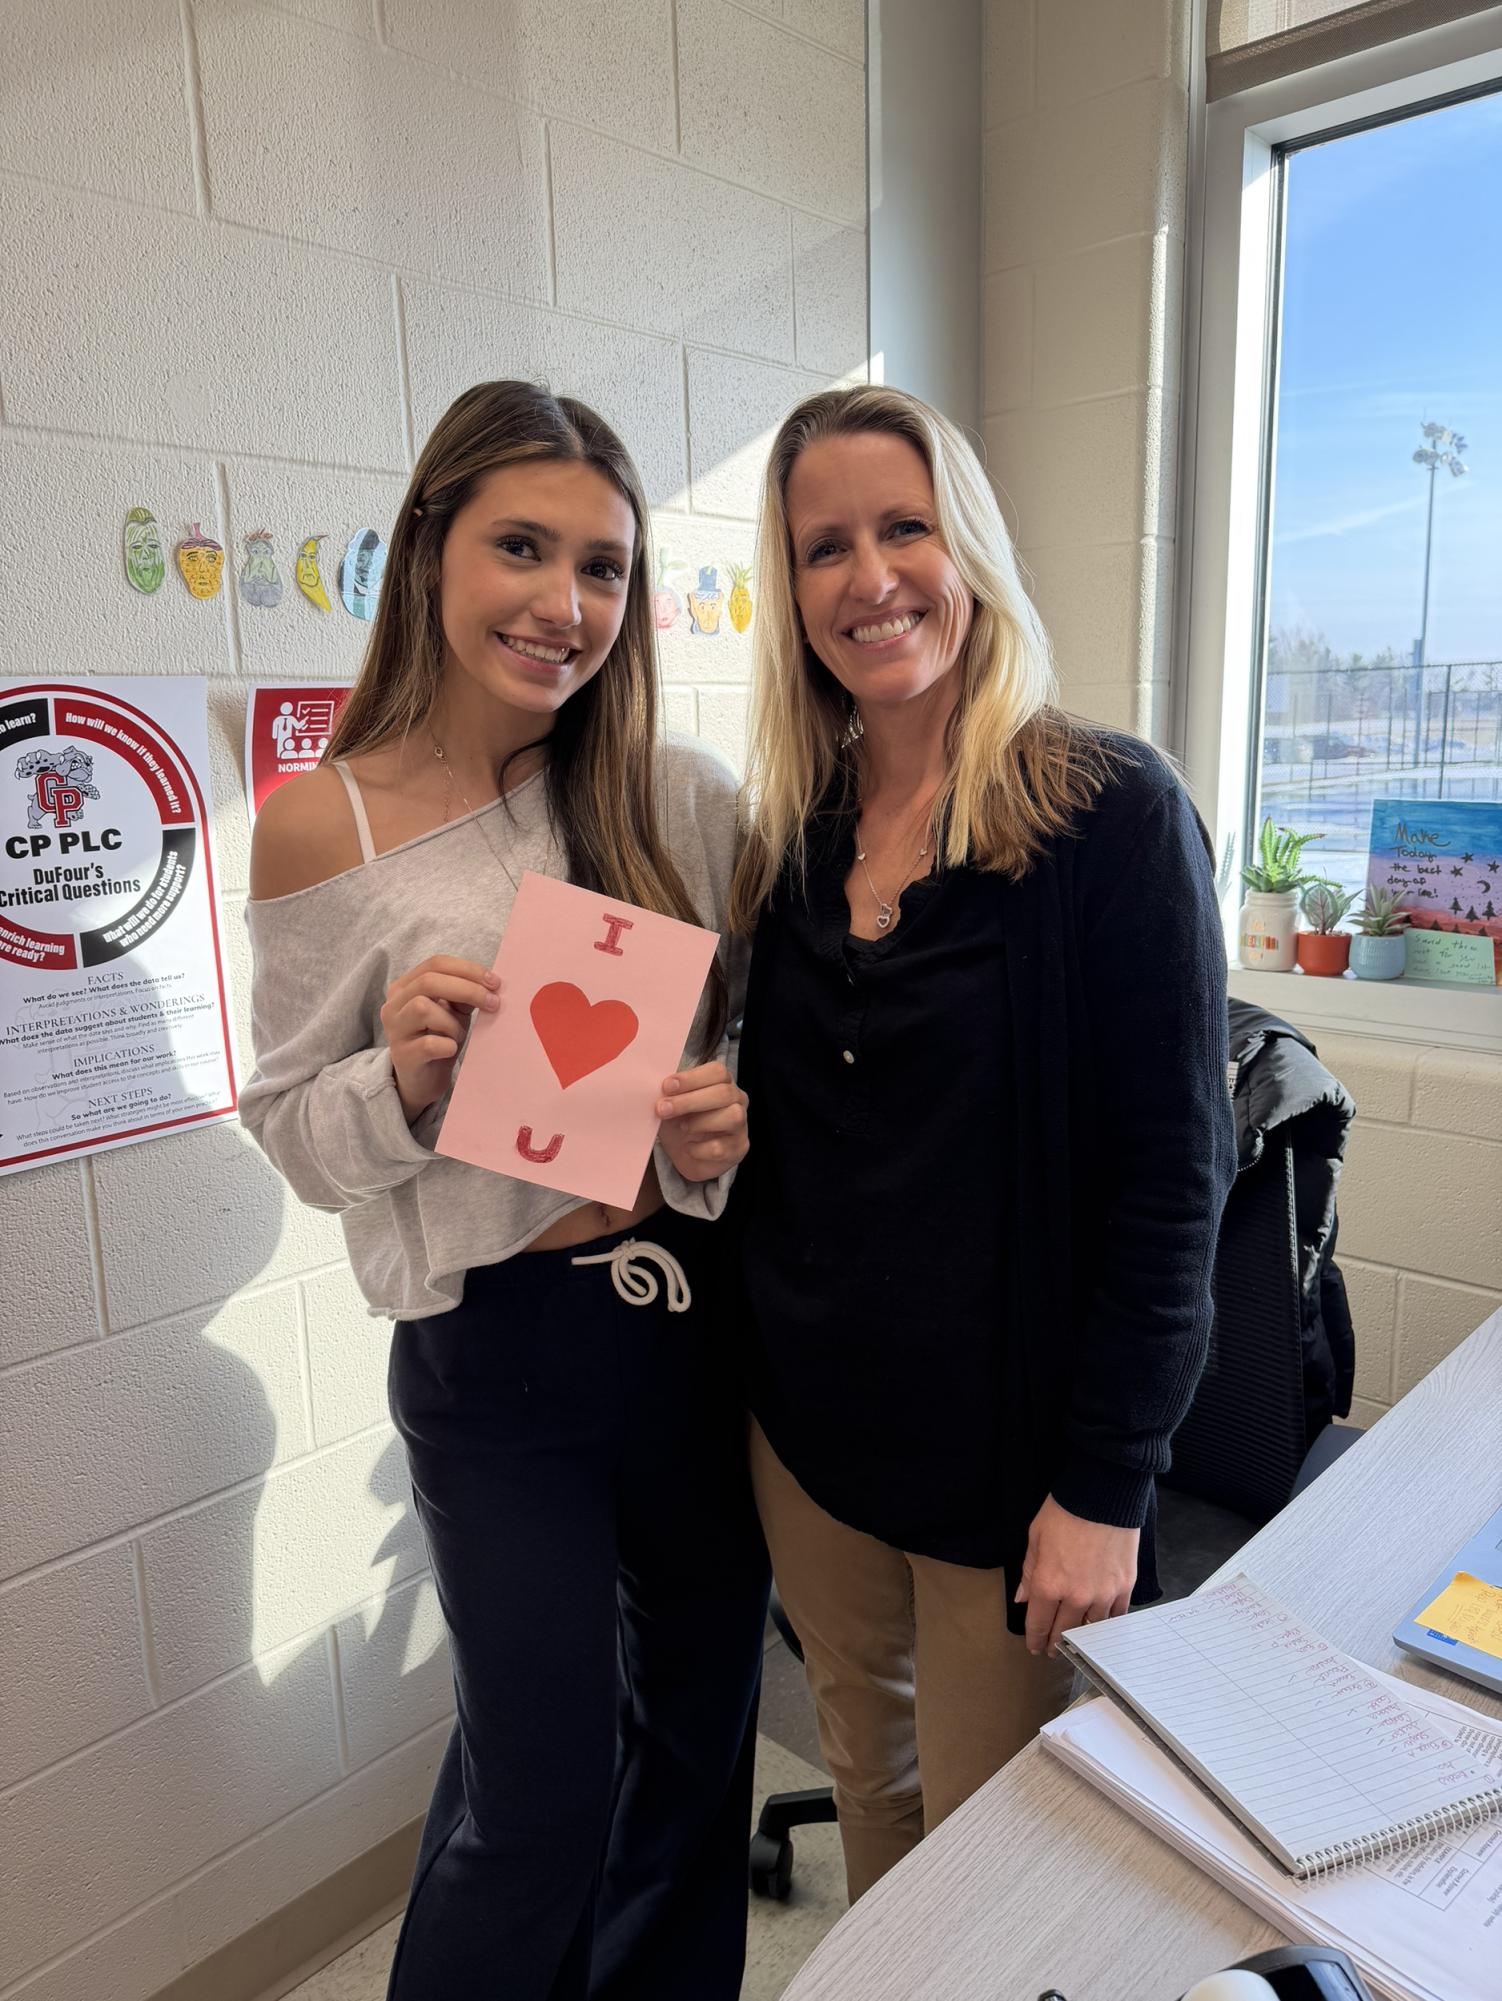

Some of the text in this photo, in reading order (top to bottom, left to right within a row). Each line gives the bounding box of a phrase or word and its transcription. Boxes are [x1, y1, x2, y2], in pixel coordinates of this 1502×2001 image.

[5, 712, 36, 730] learn?
[65, 712, 181, 814] How will we know if they learned it?
[35, 771, 84, 828] CP
[5, 828, 122, 859] CP PLC
[1394, 820, 1451, 847] Make
[1390, 846, 1437, 862] Today
[33, 862, 104, 885] DuFour's
[1390, 862, 1442, 875] the best
[0, 878, 141, 908] Critical Questions
[1387, 875, 1412, 888] day
[102, 850, 178, 943] What will we do for students
[119, 863, 187, 948] who need more support?
[26, 938, 65, 955] learning
[594, 912, 634, 956] I
[11, 947, 45, 962] ready?
[87, 972, 124, 985] FACTS
[23, 995, 44, 1004] What
[72, 988, 87, 996] see?
[89, 985, 110, 993] What
[6, 993, 205, 1036] INTERPRETATIONS & WONDERINGS
[21, 1034, 39, 1042] does
[41, 1030, 53, 1038] the
[55, 1028, 73, 1036] data
[75, 1022, 103, 1032] suggest
[105, 1018, 126, 1026] about
[128, 1013, 158, 1022] students
[184, 1002, 215, 1012] learning?
[52, 1071, 73, 1080] What
[76, 1068, 93, 1076] does
[94, 1064, 108, 1072] this
[156, 1050, 176, 1060] work?
[73, 1044, 155, 1068] IMPLICATIONS
[82, 1109, 101, 1118] what
[129, 1098, 149, 1109] going
[159, 1093, 171, 1101] do?
[88, 1087, 153, 1109] NEXT STEPS
[17, 1133, 32, 1141] What
[516, 1125, 565, 1164] U
